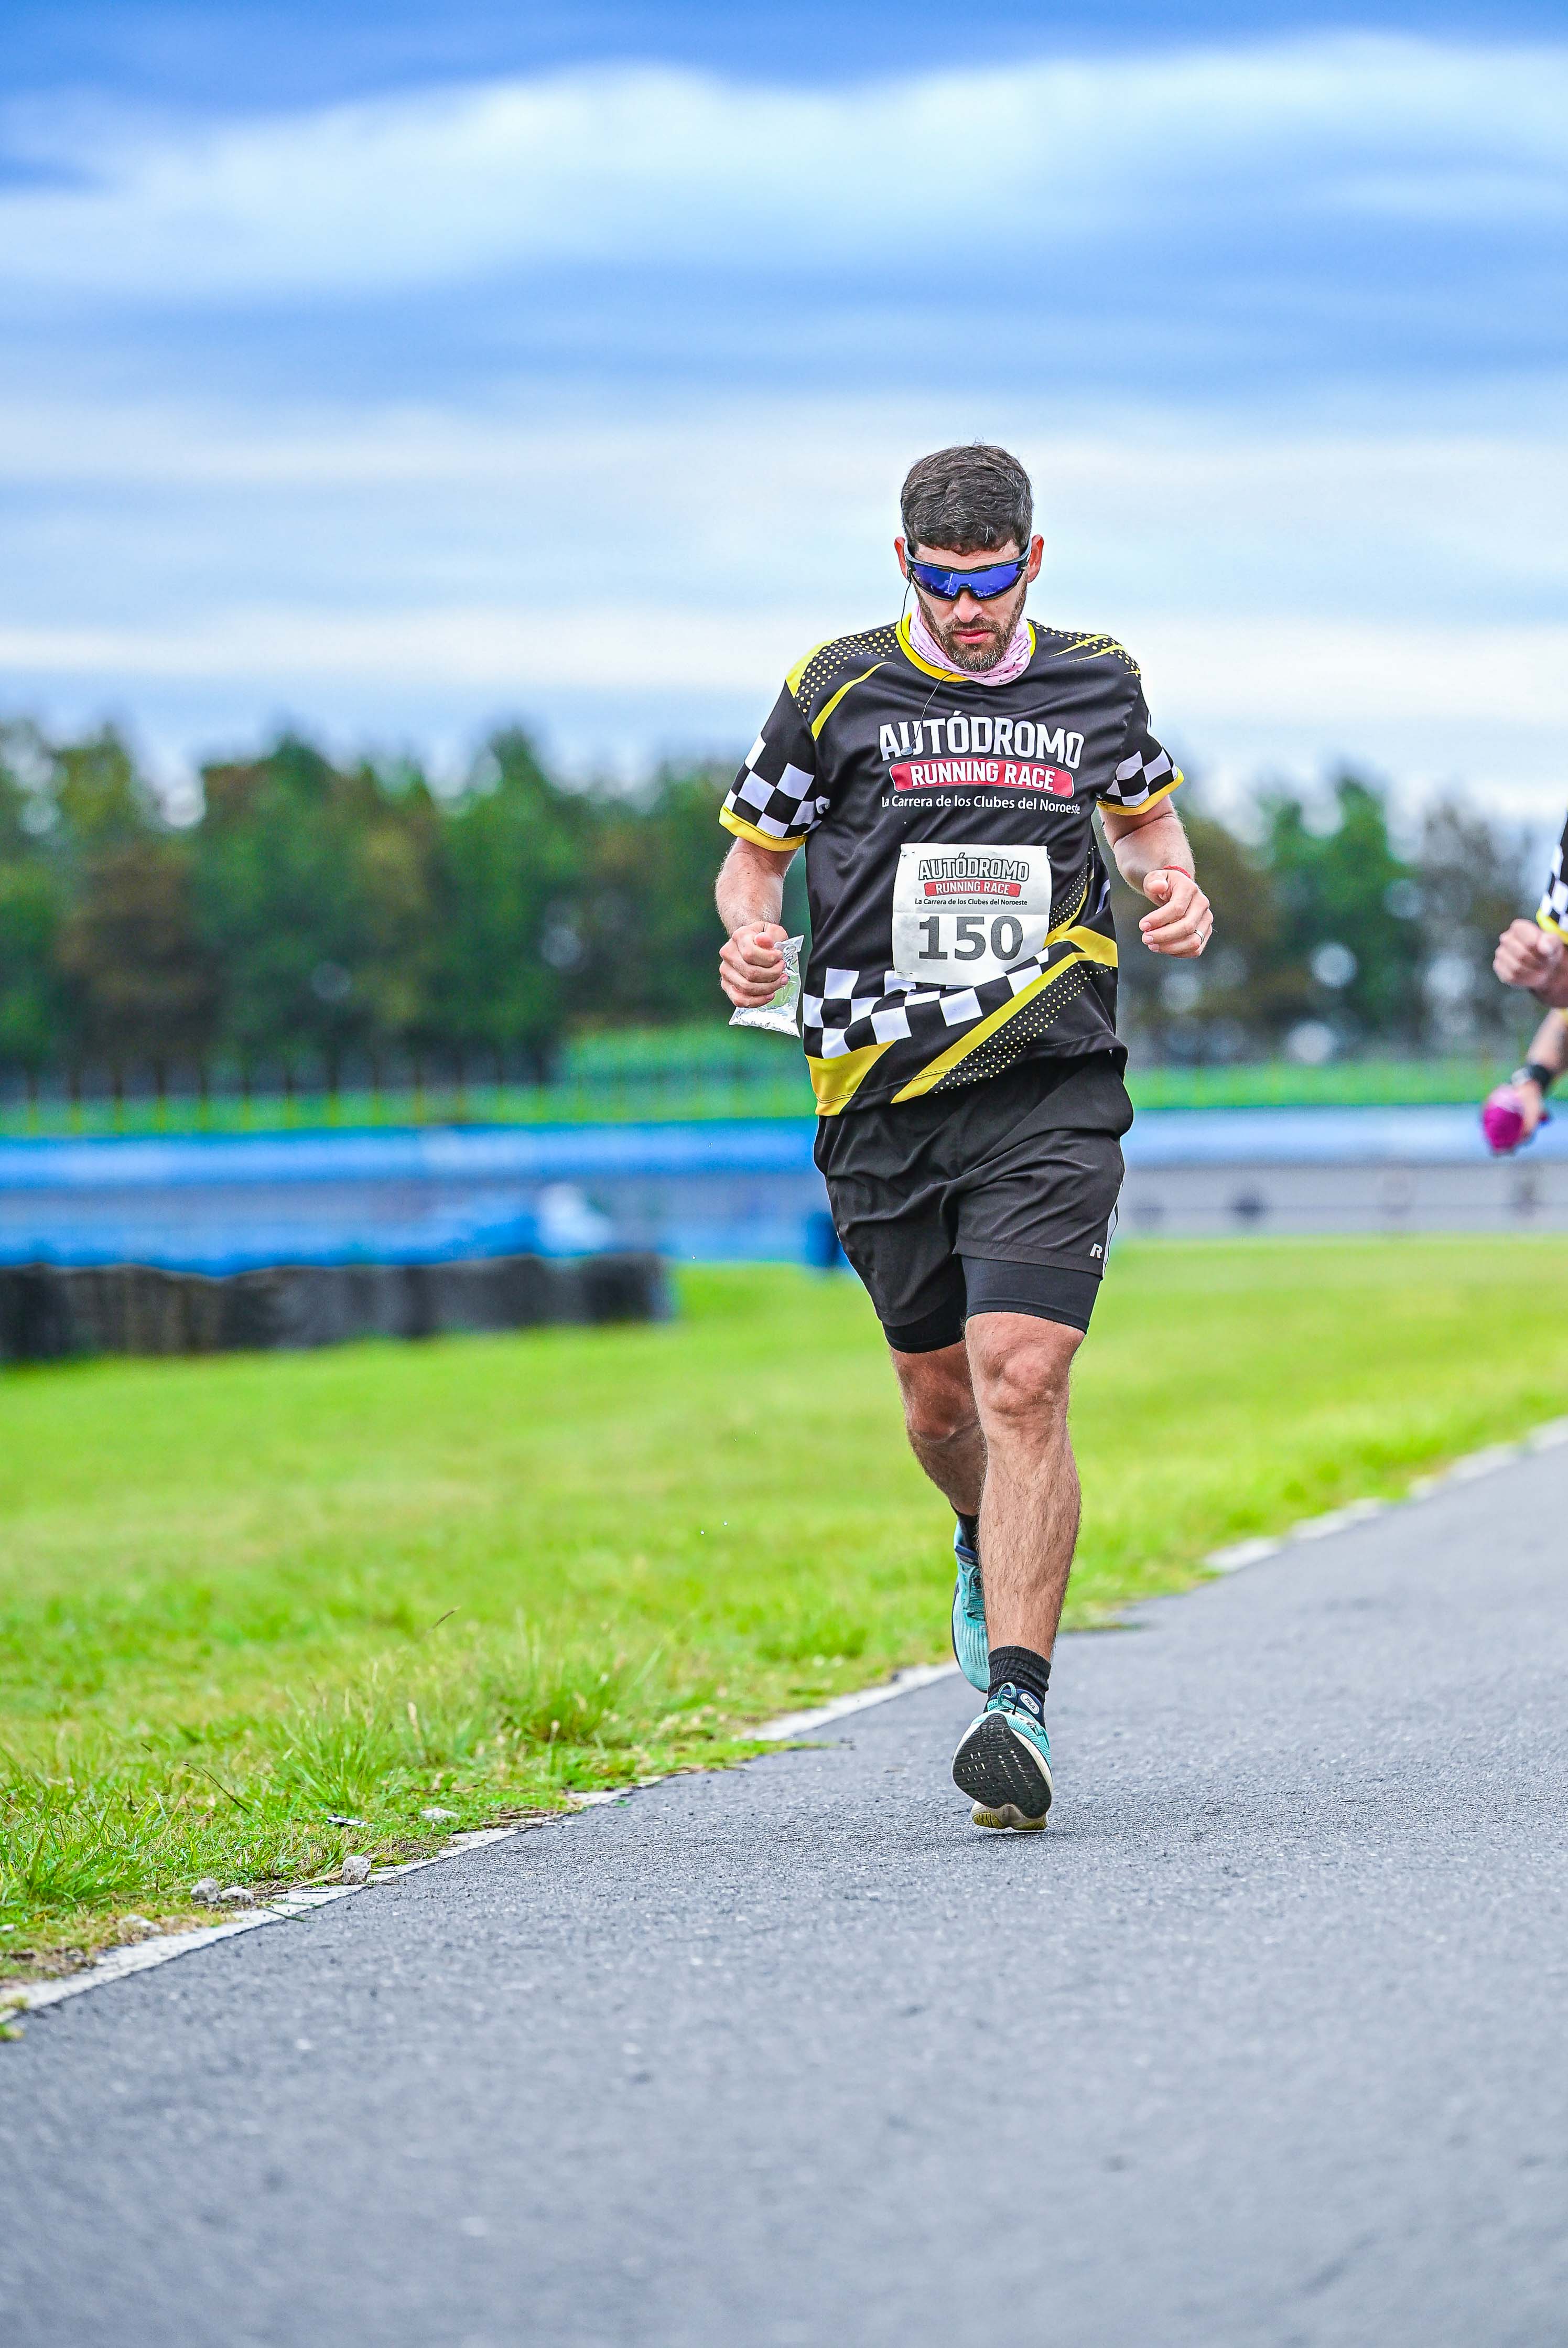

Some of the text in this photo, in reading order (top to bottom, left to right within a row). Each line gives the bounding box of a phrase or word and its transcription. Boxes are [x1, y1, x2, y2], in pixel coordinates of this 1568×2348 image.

[879, 710, 1085, 769] AUTÓDROMO
[910, 761, 1055, 791] RUNNING RACE
[891, 795, 933, 807] Carrera
[936, 795, 951, 807] de
[954, 795, 971, 807] los
[974, 795, 1014, 809] Clubes
[1018, 796, 1036, 810] del
[1040, 799, 1080, 814] Noroeste
[918, 852, 1029, 881] AUTÓDROMO
[935, 881, 1010, 895] RUNNING RACE
[918, 915, 1023, 961] 150
[1090, 1243, 1103, 1258] R
[1024, 1698, 1035, 1709] FILA
